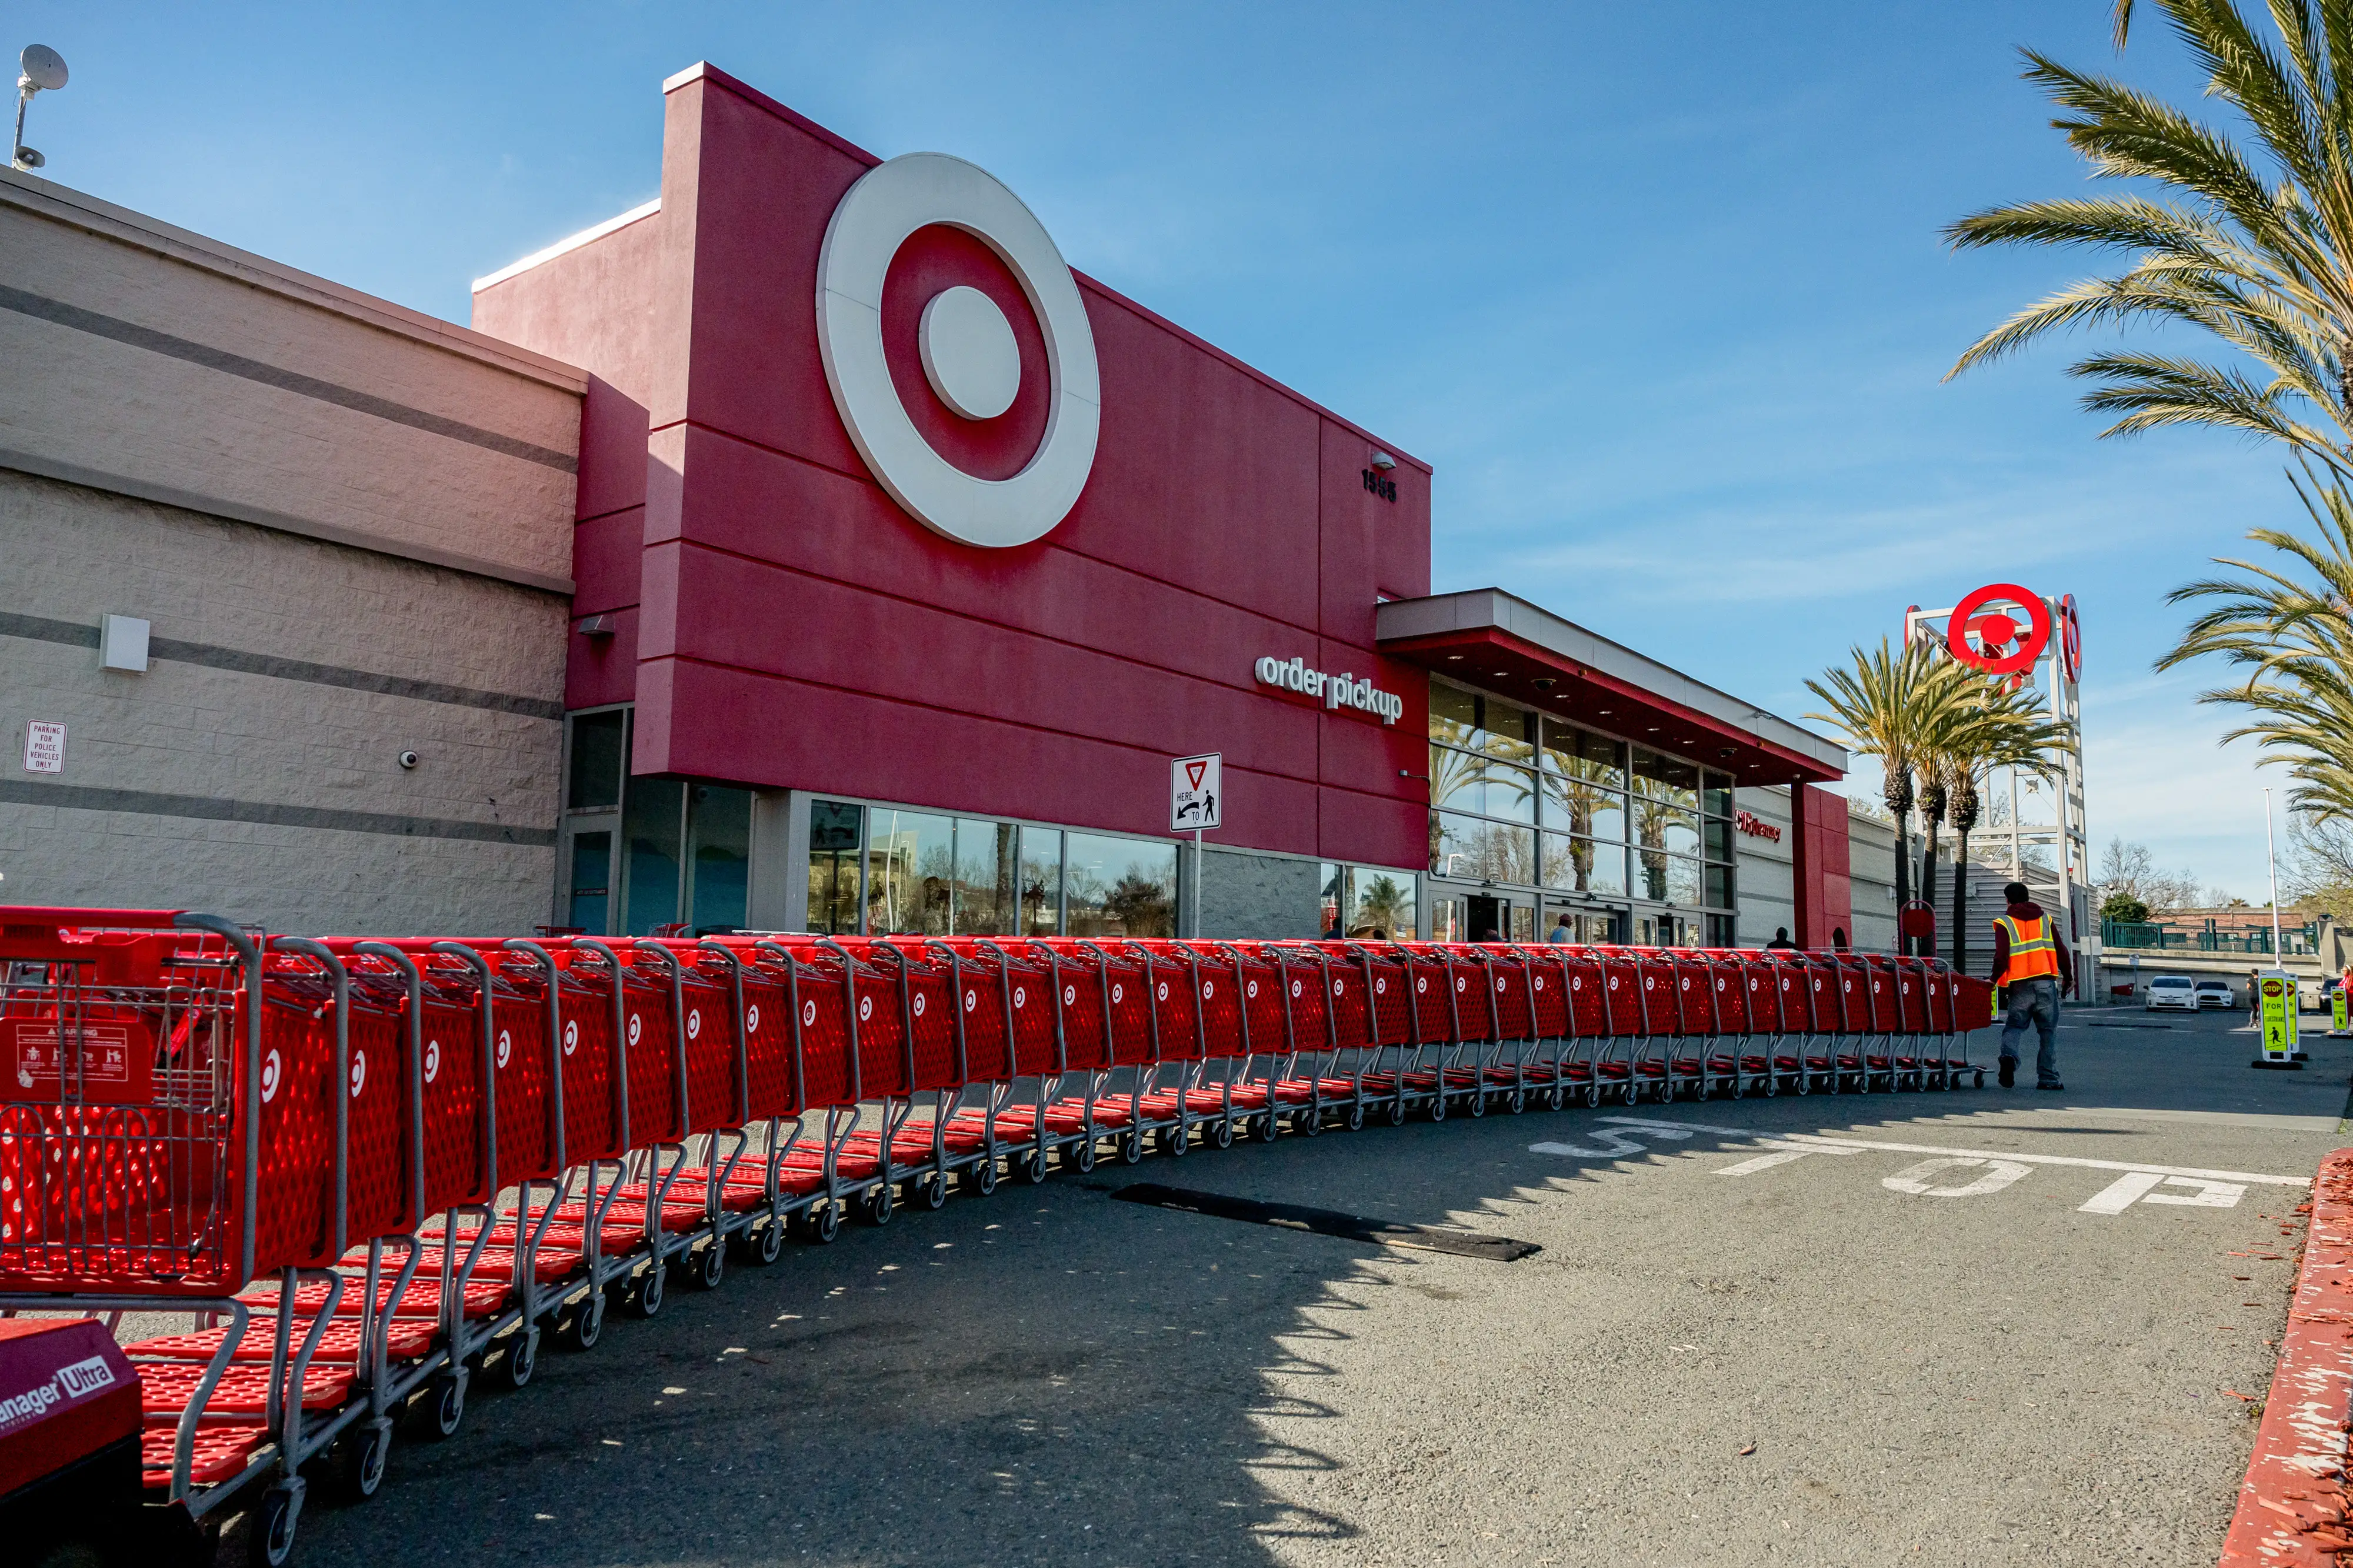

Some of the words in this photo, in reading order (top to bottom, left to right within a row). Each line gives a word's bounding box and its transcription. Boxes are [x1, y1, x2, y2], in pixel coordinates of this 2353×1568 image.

[1255, 656, 1327, 697] order
[1327, 672, 1402, 725] pickup
[34, 725, 61, 735] PARKING
[35, 743, 56, 752] POLICE
[31, 751, 59, 760] VEHICLES
[35, 760, 52, 769] ONLY
[1177, 792, 1193, 802] HERE
[1192, 811, 1199, 821] TO
[1735, 809, 1752, 832] CVS
[1528, 1126, 2248, 1215] STOP
[62, 1365, 111, 1392] Ultra
